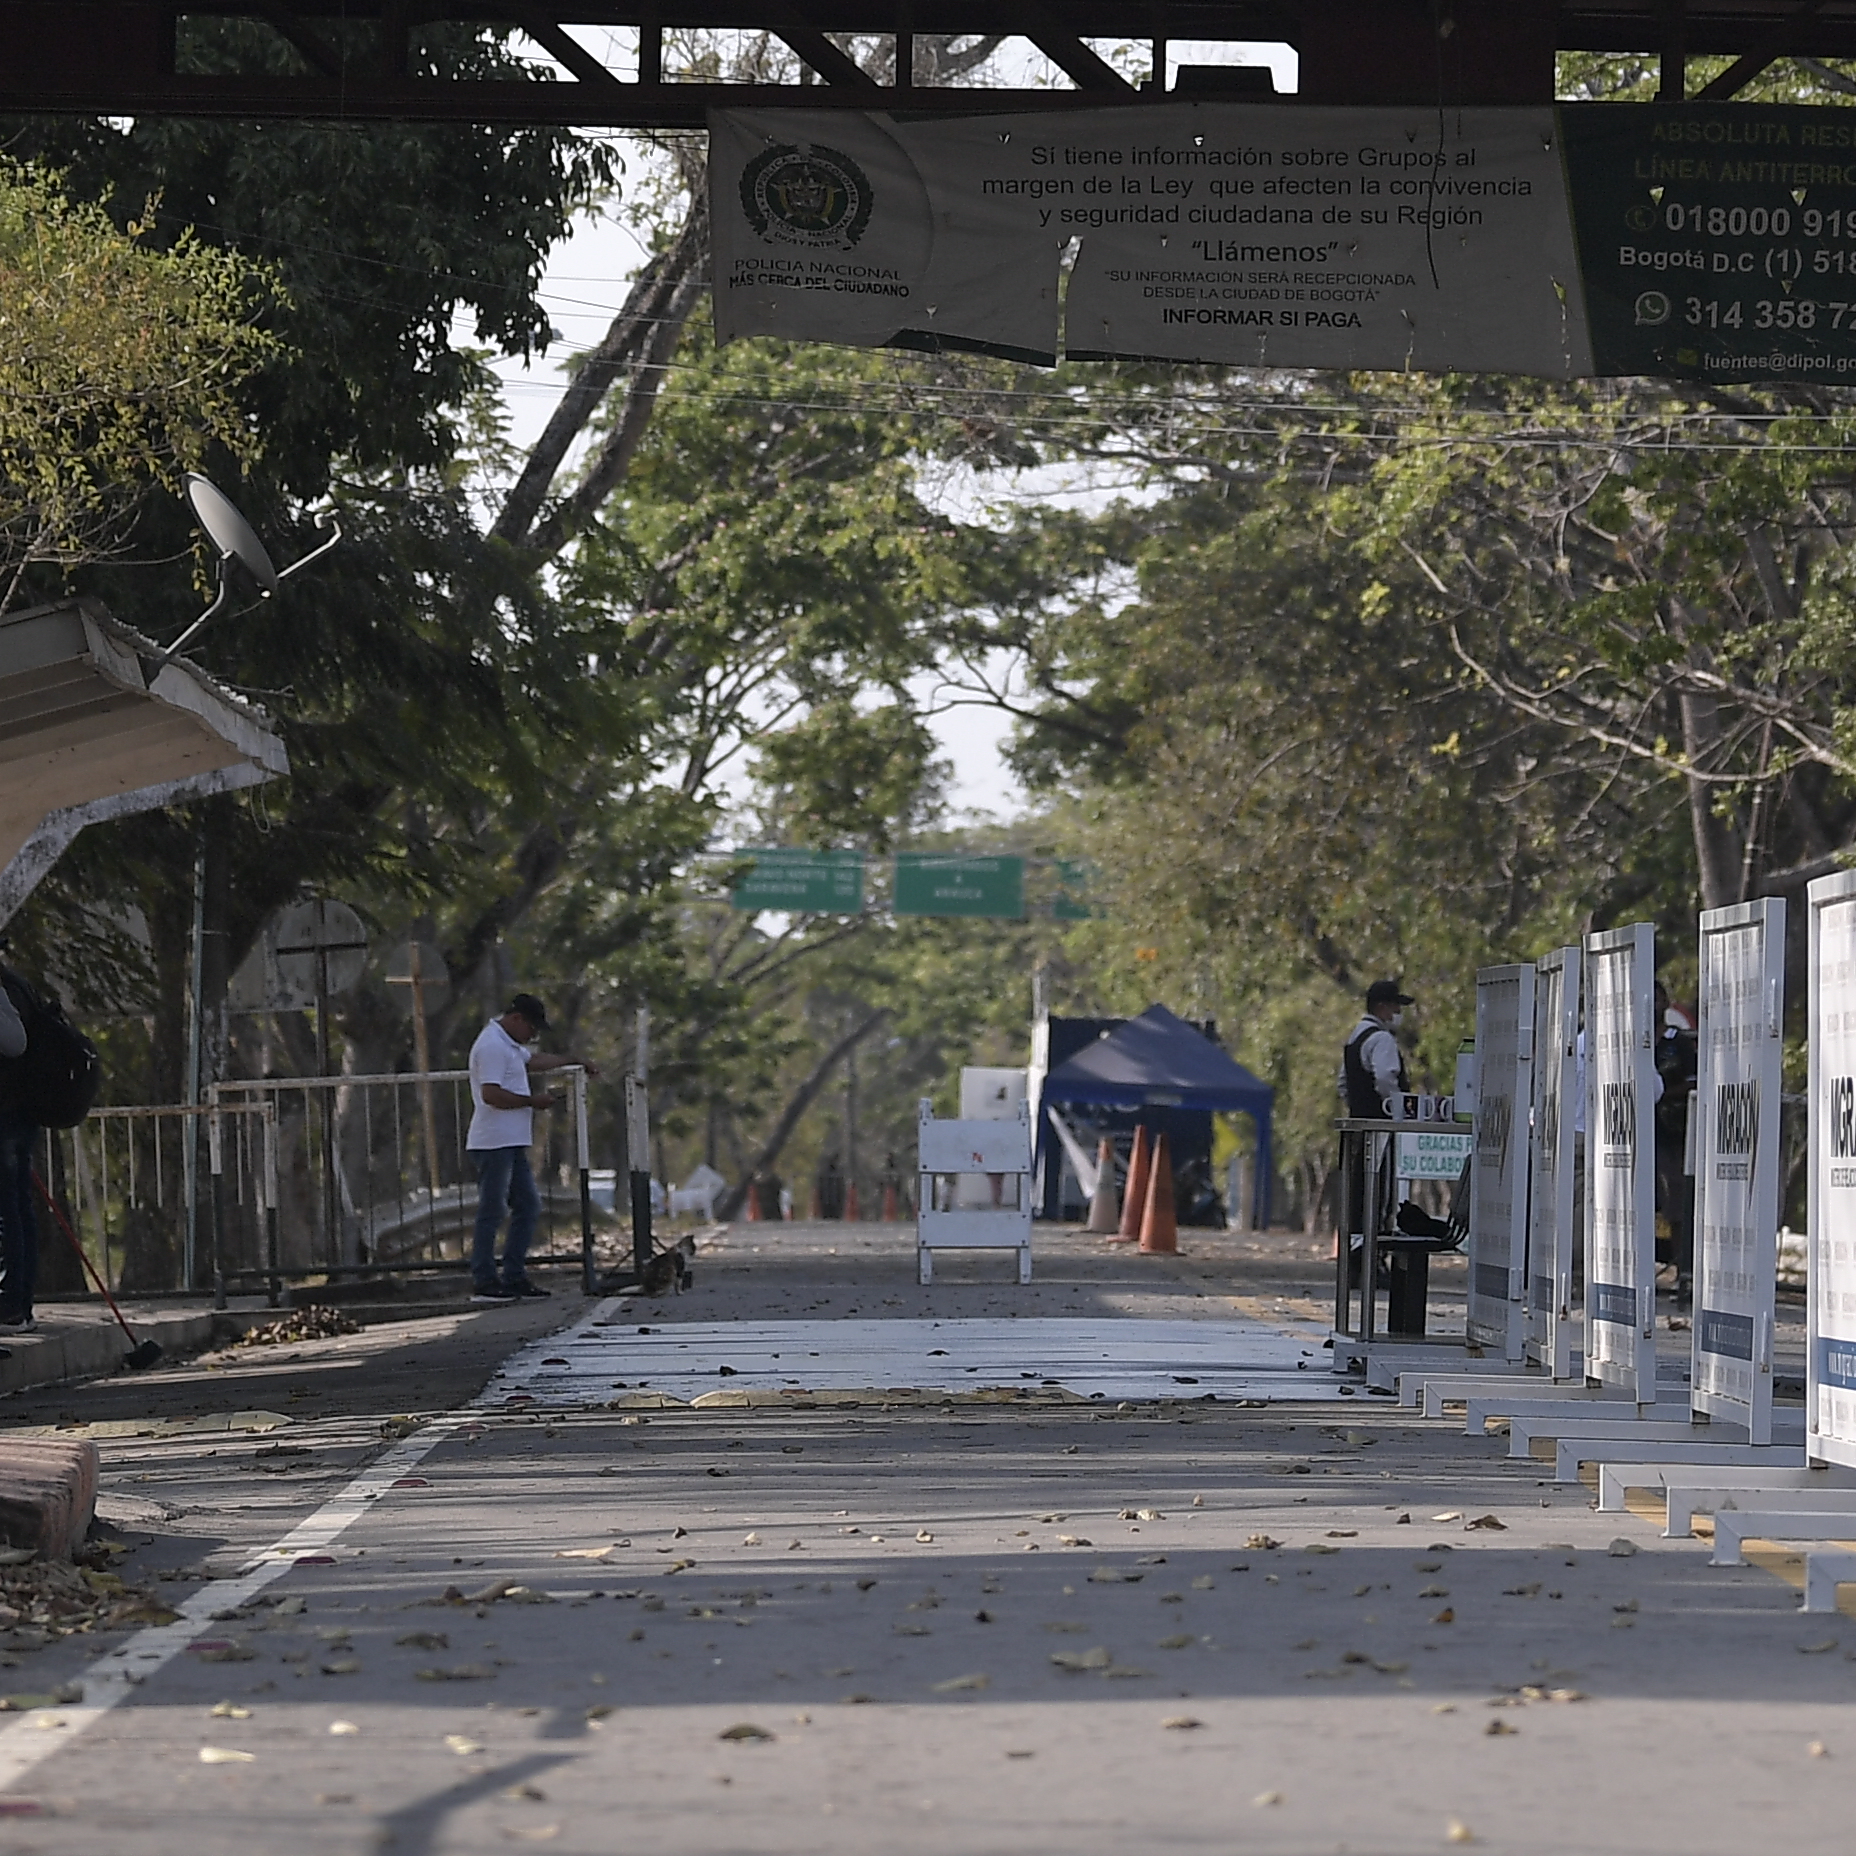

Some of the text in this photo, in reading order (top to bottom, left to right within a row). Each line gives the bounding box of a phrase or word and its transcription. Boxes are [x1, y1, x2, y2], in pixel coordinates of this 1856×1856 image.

[1651, 121, 1791, 145] ABSOLUTA
[1064, 147, 1123, 166] tiene
[1132, 147, 1272, 167] información
[1281, 148, 1349, 167] sobre
[1358, 147, 1446, 171] Grupos
[1456, 148, 1476, 166] al
[1634, 153, 1710, 180] LÍNEA
[982, 175, 1532, 199] margen de la Ley que afecten la convivencia
[1038, 204, 1483, 230] y seguridad ciudadana de su Región
[1665, 202, 1791, 237] 018000
[735, 258, 902, 281] POLICIA NACIONAL
[1619, 246, 1705, 271] Bogotá
[1764, 247, 1803, 279] (1)
[834, 278, 910, 298] CIUDADANO
[1294, 272, 1416, 287] RECEPCIONADA
[1143, 286, 1195, 299] DESDE
[1200, 287, 1218, 299] LA
[1222, 287, 1280, 300] CIUDAD
[1283, 289, 1305, 301] DE
[1162, 308, 1363, 328] INFORMAR SI PAGA
[1685, 296, 1743, 329] 314
[1754, 299, 1816, 330] 358
[1418, 1135, 1463, 1151] GRACIAS
[1403, 1155, 1417, 1171] SU
[1420, 1156, 1465, 1172] COLABO
